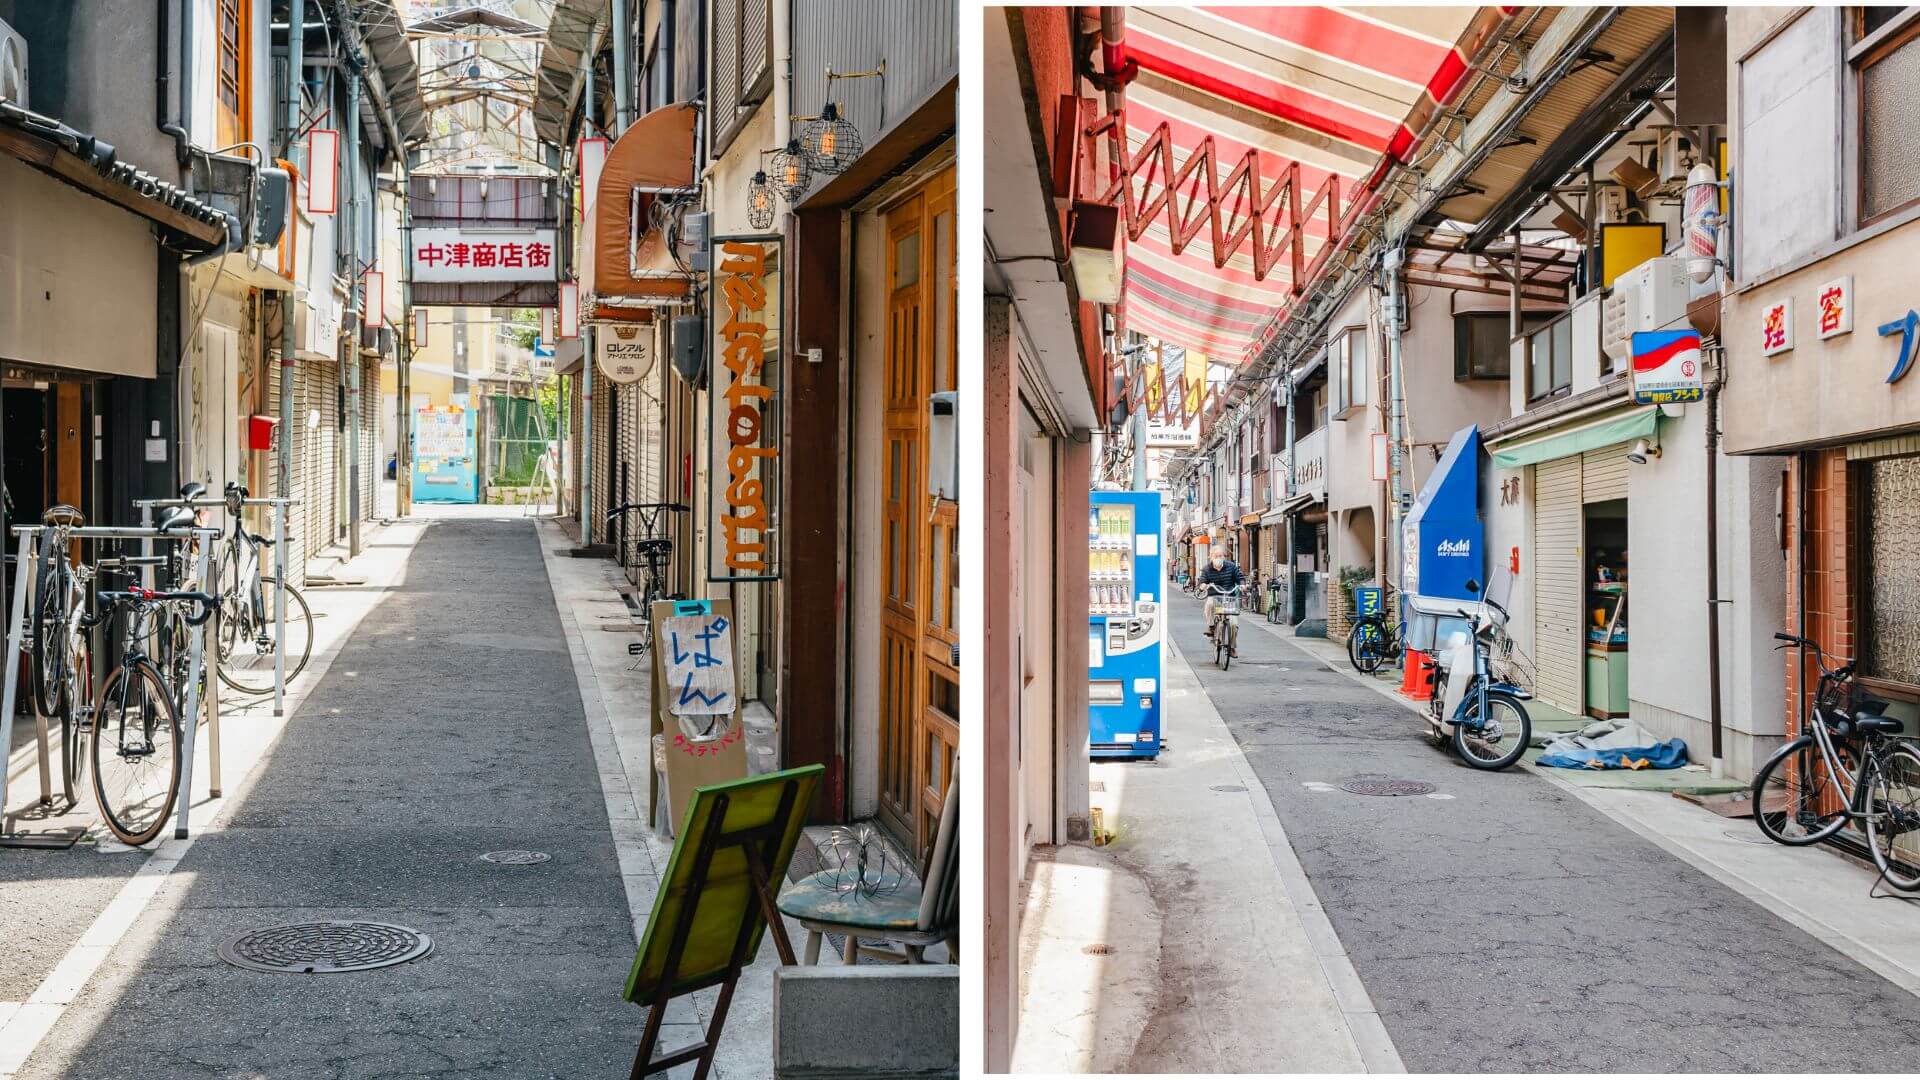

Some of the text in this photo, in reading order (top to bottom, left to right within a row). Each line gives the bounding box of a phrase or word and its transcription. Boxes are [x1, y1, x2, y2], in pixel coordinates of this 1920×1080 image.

[418, 242, 551, 268] 中津商店街
[607, 343, 646, 352] ロレアル
[1438, 539, 1470, 551] Asahi
[671, 617, 728, 706] ぱん
